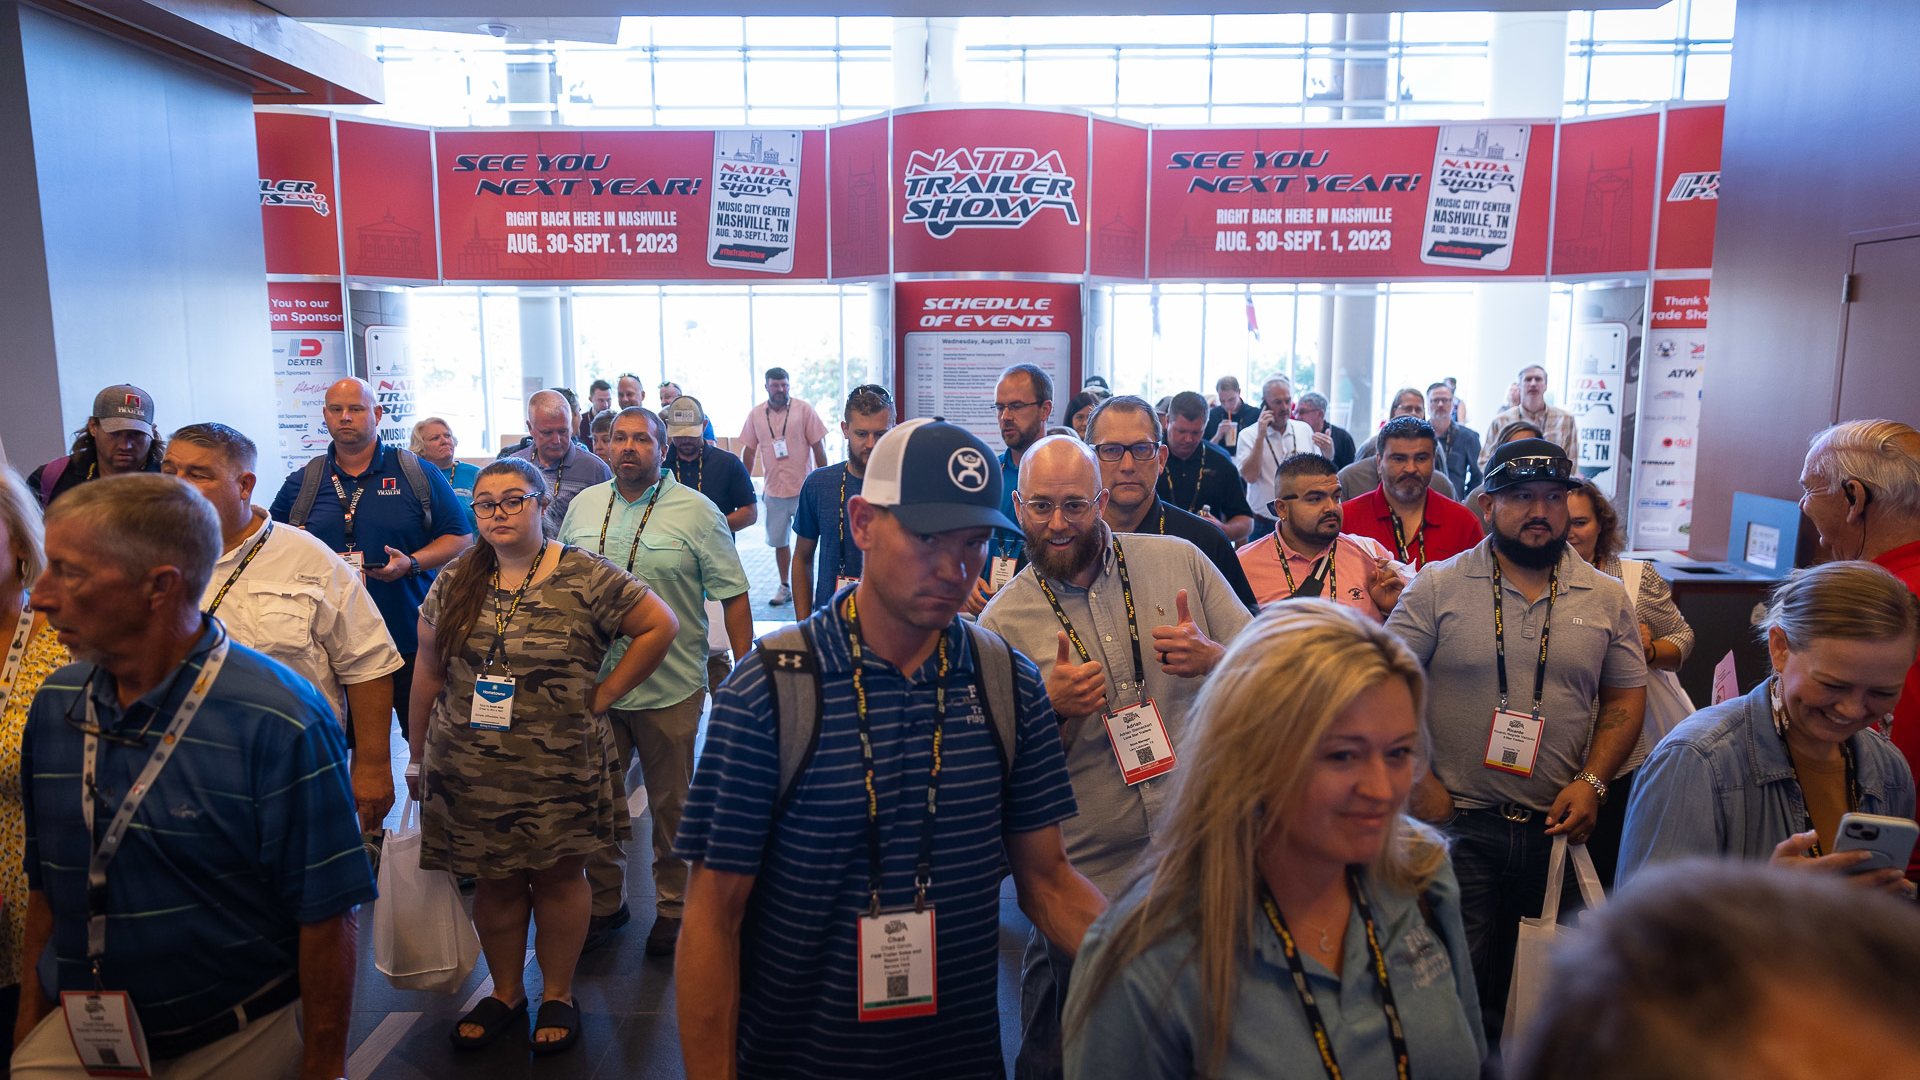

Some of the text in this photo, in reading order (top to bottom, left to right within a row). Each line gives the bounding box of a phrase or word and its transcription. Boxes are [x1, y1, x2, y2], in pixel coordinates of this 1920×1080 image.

[452, 154, 611, 172] SEE YOU
[905, 148, 1066, 176] NATDA
[1166, 150, 1330, 170] SEE YOU
[1442, 159, 1511, 173] NATDA
[720, 163, 787, 177] NATDA
[1440, 168, 1515, 182] TRAILER
[475, 178, 703, 195] NEXT YEAR!
[719, 173, 792, 187] TRAILER
[904, 174, 1075, 199] TRAILER
[1187, 174, 1423, 194] NEXT YEAR!
[1438, 178, 1496, 190] SHOW
[718, 182, 780, 195] SHOW
[285, 193, 325, 201] EXPO
[717, 201, 791, 218] MUSIC CITY CENTER
[904, 197, 1042, 221] SHOW
[1435, 197, 1511, 213] MUSIC CITY CENTER
[505, 211, 678, 226] RIGHT BACK HERE IN NASHVILLE
[716, 213, 789, 232] NASHVILLE, TN
[1216, 207, 1393, 225] RIGHT BACK HERE IN NASHVILLE
[1433, 209, 1510, 228] NASHVILLE, TN
[715, 228, 731, 238] AUG.
[770, 233, 789, 243] 2023
[1431, 224, 1447, 234] AUG.
[1488, 229, 1508, 239] 2023
[507, 233, 678, 256] AUG. 30-SEPT. 1, 2023
[1215, 229, 1392, 253] AUG. 30-SEPT. 1, 2023
[270, 298, 330, 308] You to our
[922, 297, 1052, 310] SCHEDULE
[1664, 296, 1701, 306] Thank
[290, 311, 343, 325] Sponsor
[919, 315, 1055, 328] OF EVENTS
[941, 338, 981, 346] Wednesday,
[981, 338, 1004, 346] August
[287, 358, 323, 366] DEXTER
[1667, 369, 1697, 378] ATW
[380, 427, 406, 441] MUSIC
[1581, 428, 1612, 441] CENTER
[1674, 437, 1692, 448] dpl
[1595, 444, 1610, 461] TN
[1126, 721, 1142, 730] Adrian
[1506, 727, 1524, 735] Ricardo
[887, 935, 906, 943] Chad
